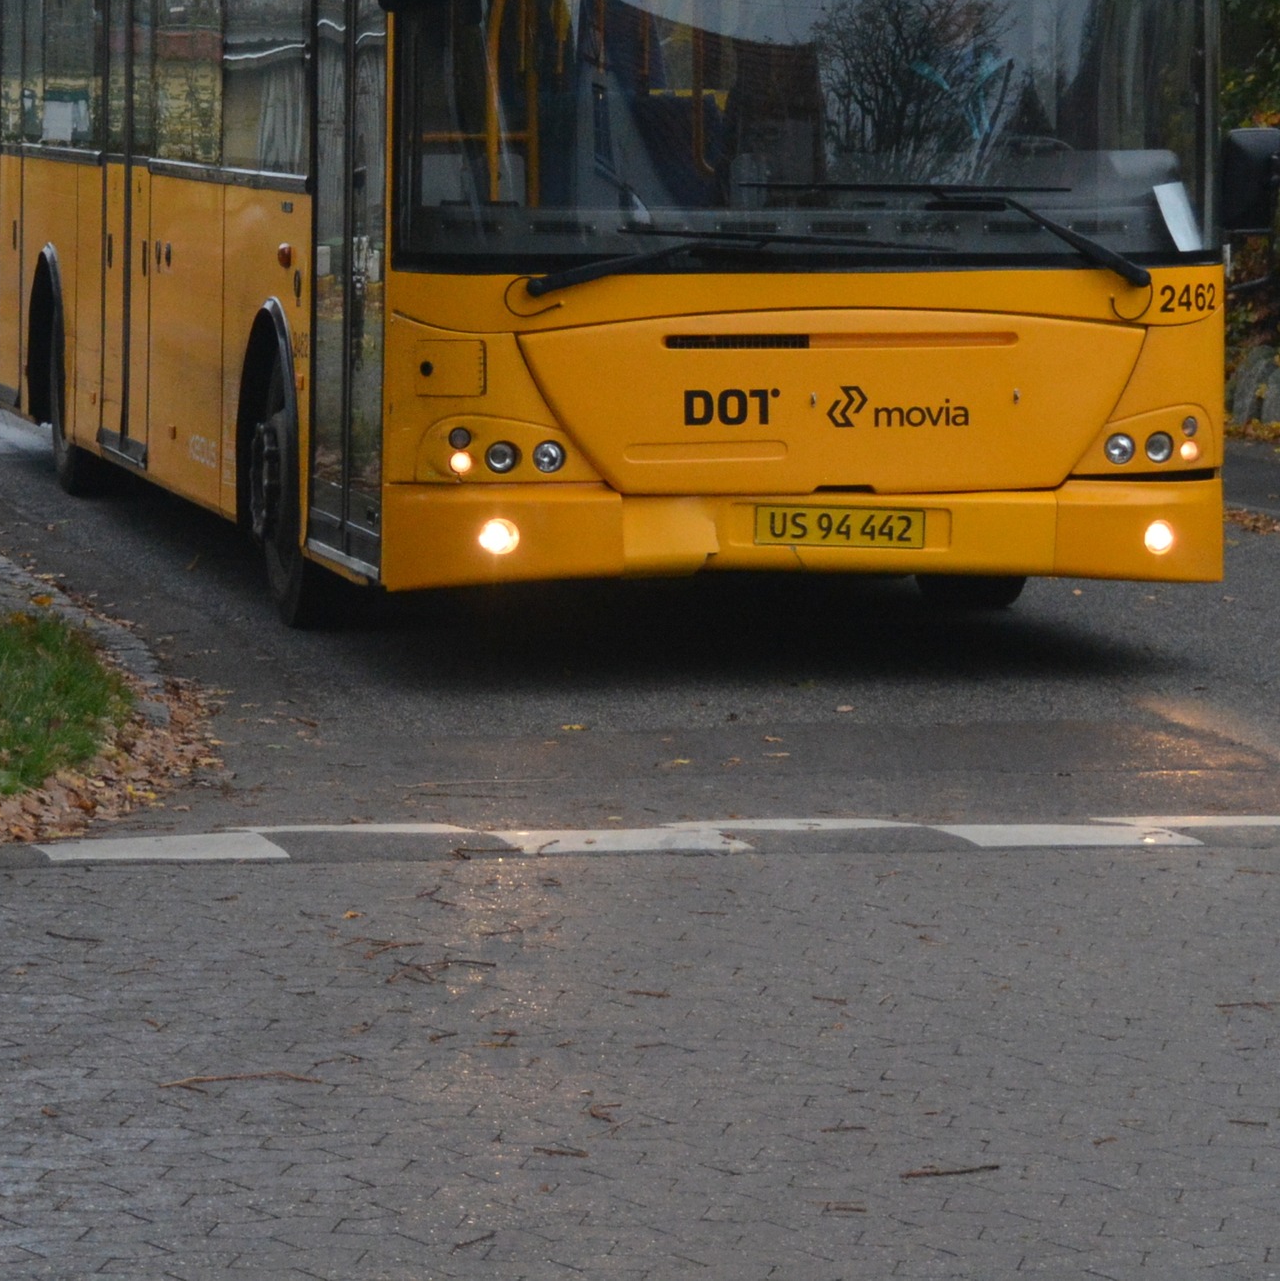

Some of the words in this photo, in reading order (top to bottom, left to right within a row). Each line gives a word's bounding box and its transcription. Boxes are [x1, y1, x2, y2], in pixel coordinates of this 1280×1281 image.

[1160, 282, 1216, 313] 2462
[683, 388, 781, 426] DOT
[873, 398, 970, 428] movia
[769, 511, 808, 539] US
[816, 512, 851, 541] 94
[860, 514, 912, 542] 442
